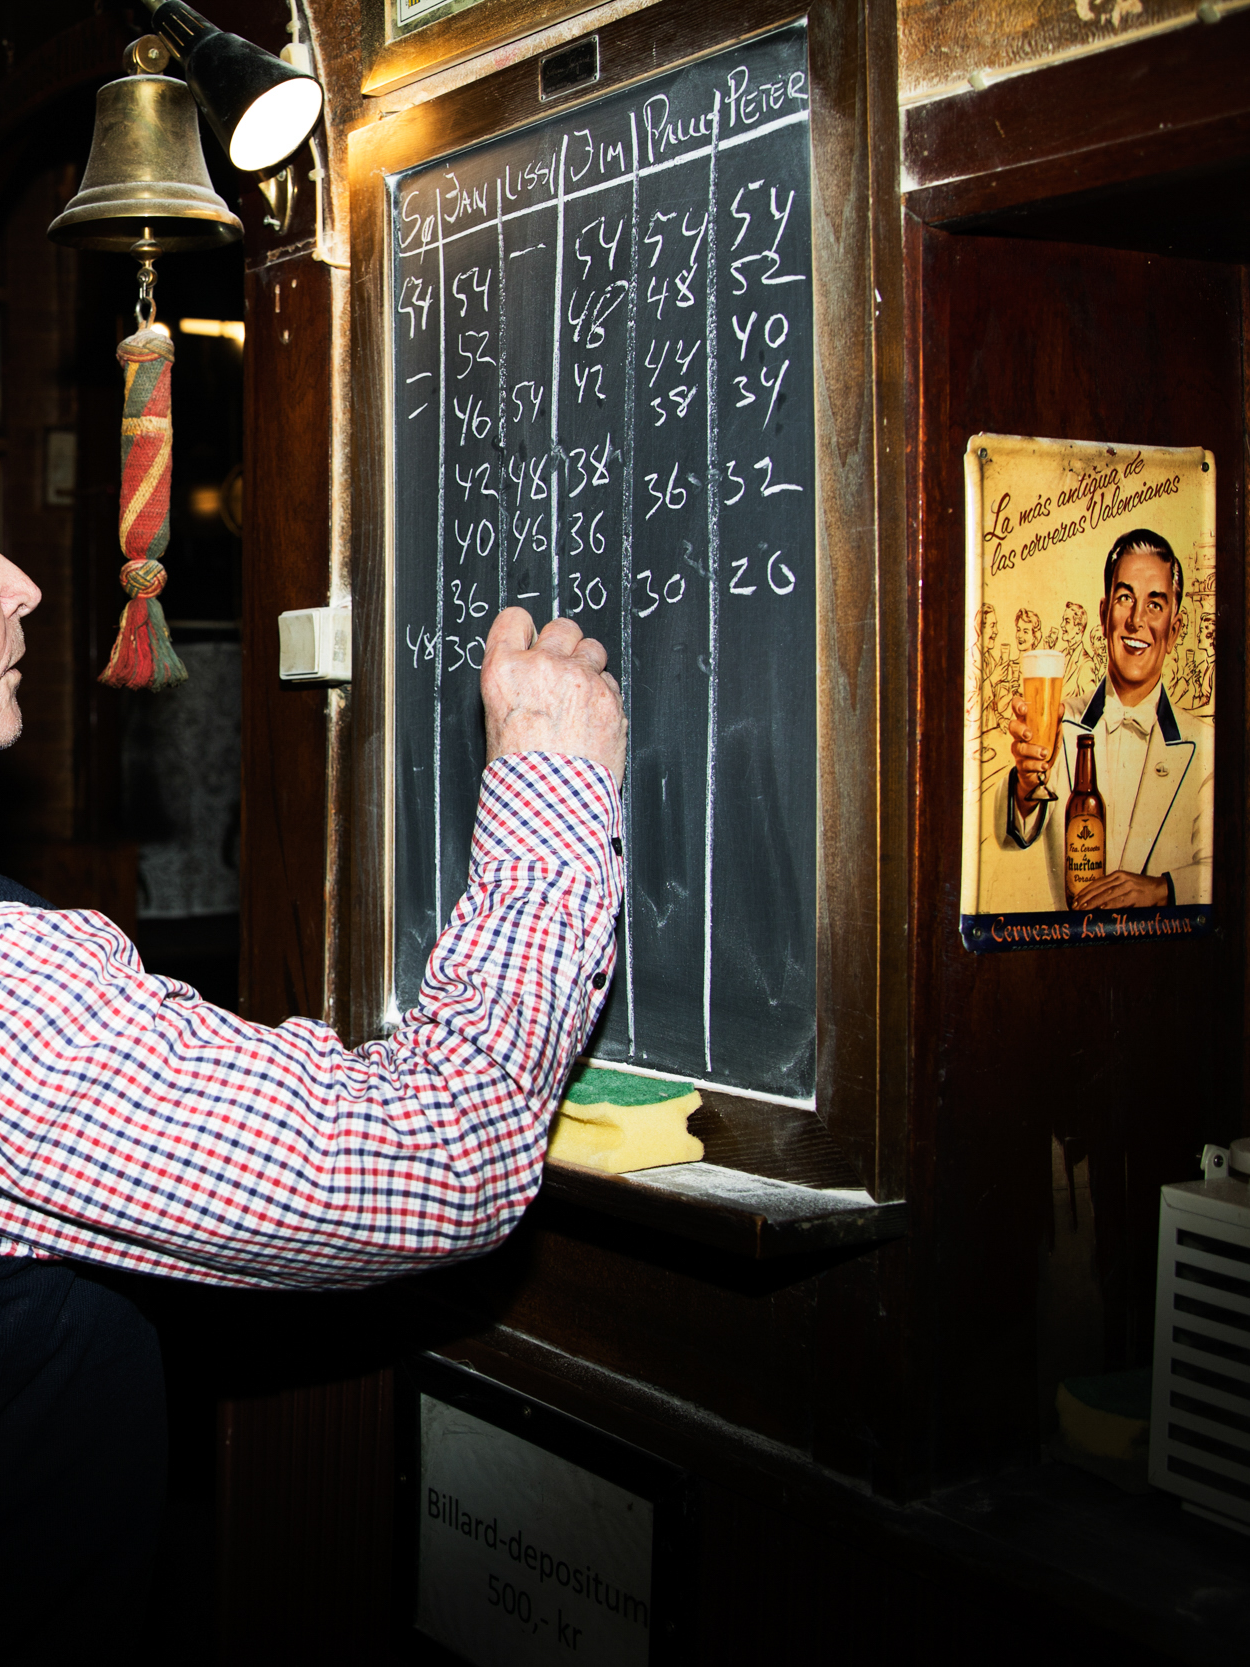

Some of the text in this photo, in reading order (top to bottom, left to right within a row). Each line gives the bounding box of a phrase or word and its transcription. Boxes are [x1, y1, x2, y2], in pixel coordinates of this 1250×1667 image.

[443, 163, 487, 224] JAN
[570, 129, 625, 182] JIM
[725, 65, 809, 128] PETER
[398, 276, 433, 340] 54
[452, 267, 491, 318] 54
[574, 215, 624, 280] 54
[644, 208, 709, 269] 54
[730, 179, 795, 260] 54
[568, 250, 806, 349] 48 48 52
[457, 331, 497, 379] 52
[574, 363, 607, 404] 42
[644, 339, 701, 388] 44
[732, 311, 789, 361] 40
[453, 394, 491, 446] 46
[511, 380, 543, 423] 54
[650, 384, 698, 426] 38
[732, 360, 790, 431] 34
[455, 432, 803, 521] 42 48 38 36 32
[984, 492, 1014, 542] La
[1019, 494, 1051, 527] más
[1123, 450, 1145, 478] de
[455, 510, 605, 565] 40 46 36
[990, 475, 1180, 576] las cervezas Valencianas
[450, 579, 489, 622] 36
[568, 572, 607, 613] 30
[636, 569, 685, 618] 30
[406, 624, 485, 672] 48 30
[991, 911, 1193, 943] Cervezas La Huertana
[428, 1487, 648, 1629] Billard-depositum
[488, 1573, 582, 1651] 500,- kr
